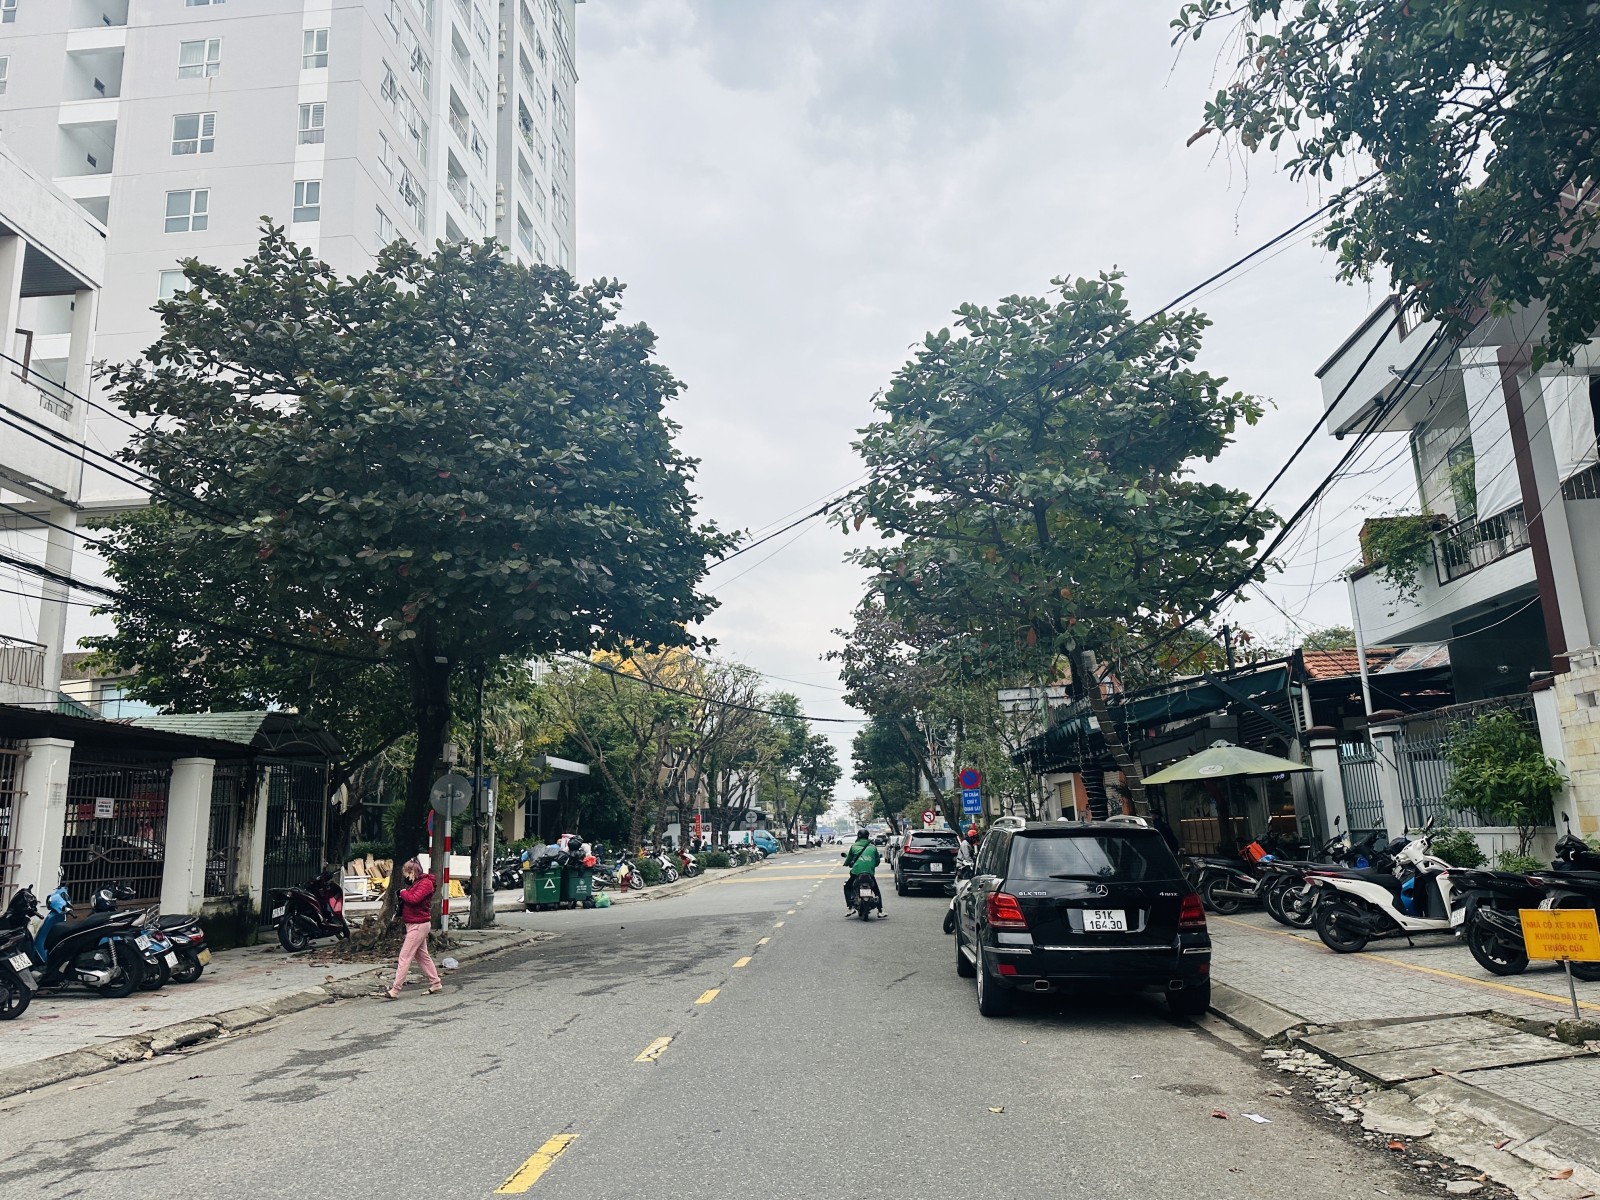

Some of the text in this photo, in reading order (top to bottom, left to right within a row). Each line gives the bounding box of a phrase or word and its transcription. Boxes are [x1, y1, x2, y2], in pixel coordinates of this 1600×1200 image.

[1095, 910, 1114, 920] 51K
[1090, 920, 1123, 930] 164.30
[1526, 920, 1541, 928] NHÀ
[1555, 921, 1565, 929] XE
[1579, 933, 1589, 941] XE
